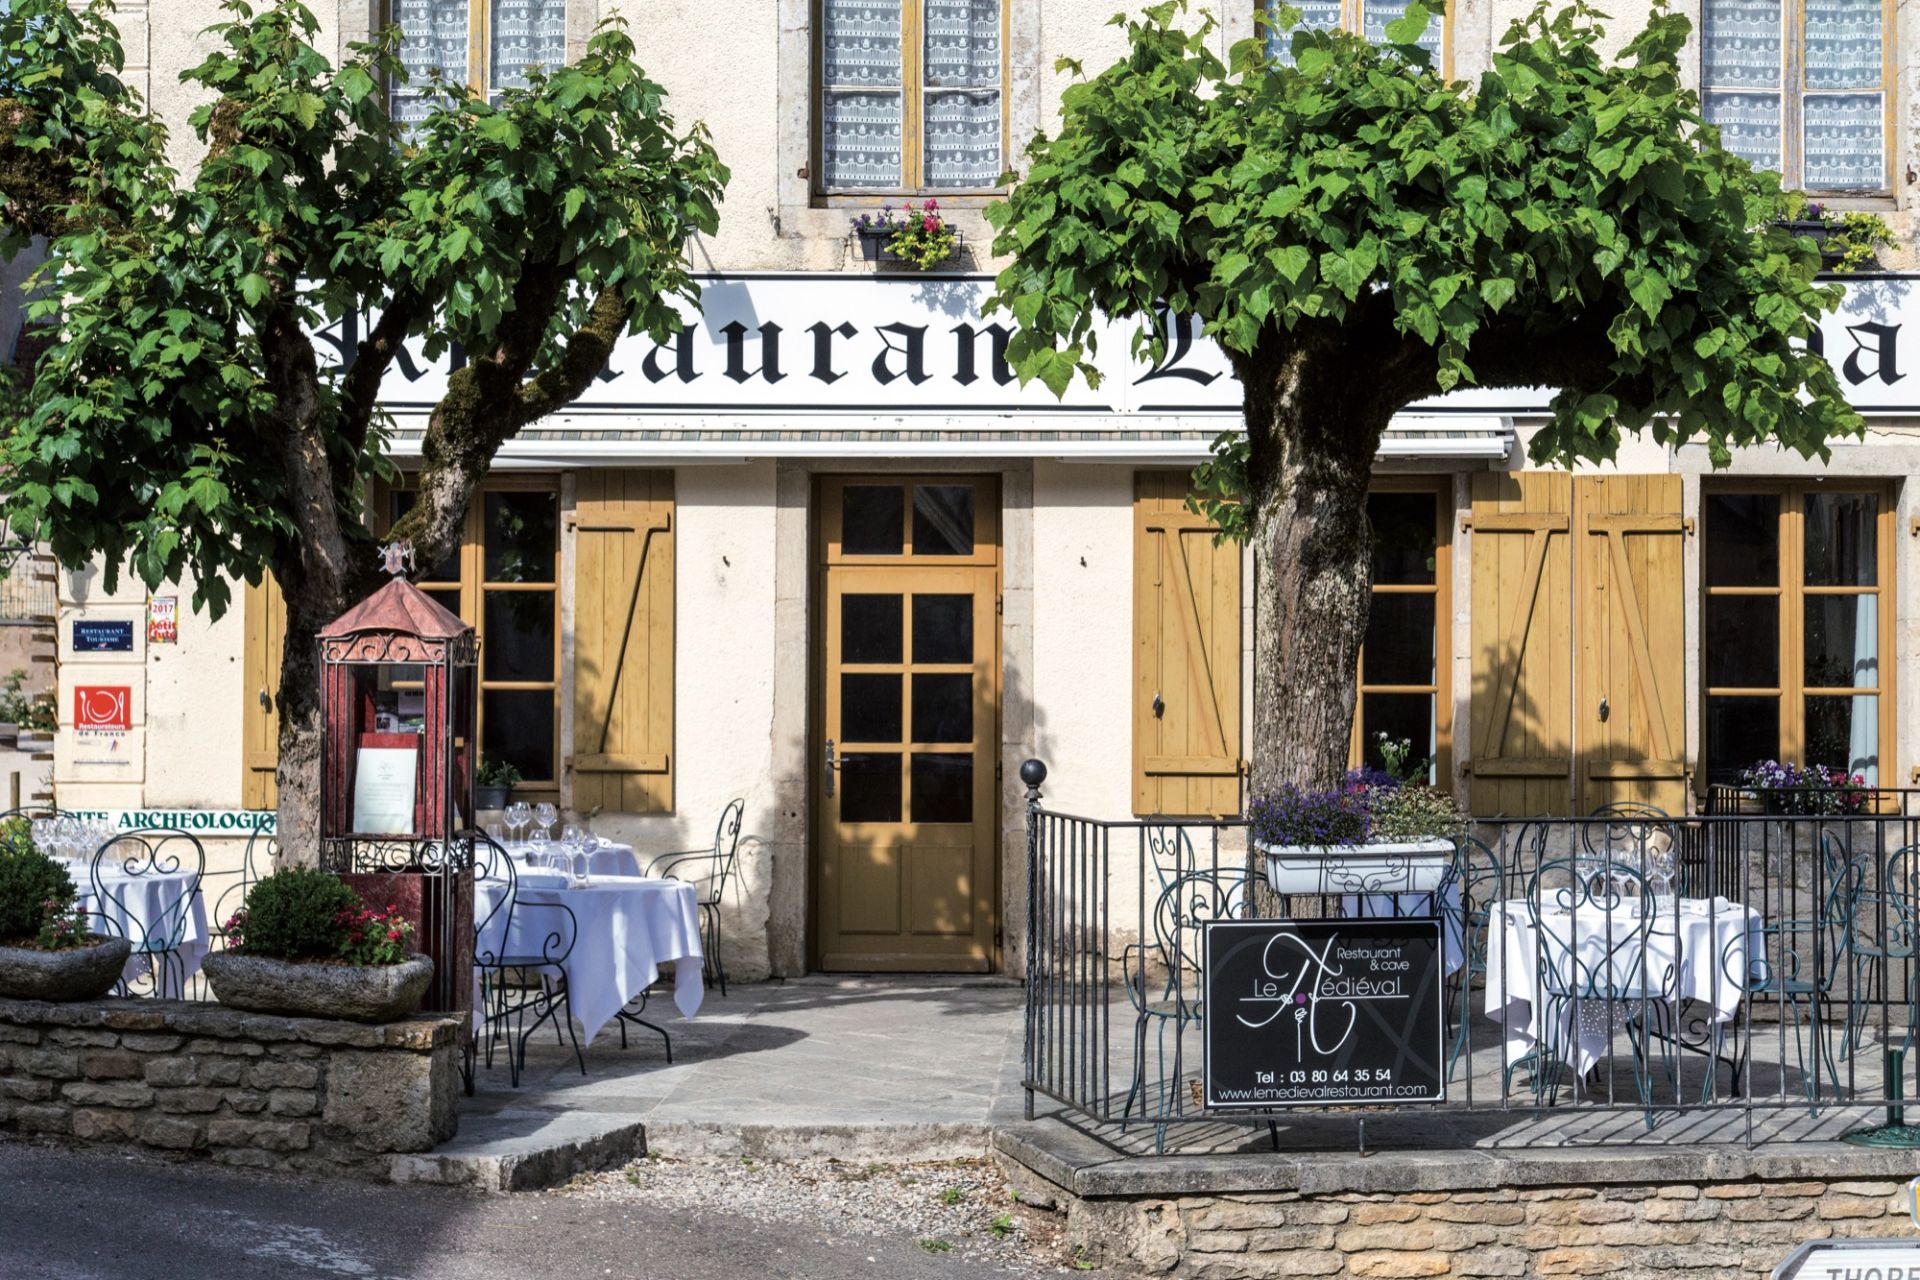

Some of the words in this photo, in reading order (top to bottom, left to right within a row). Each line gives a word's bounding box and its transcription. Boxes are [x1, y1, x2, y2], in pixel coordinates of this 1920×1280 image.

[152, 604, 174, 613] 2017
[78, 722, 126, 731] Restaurateurs
[117, 811, 276, 832] ARCHEOLOGIQ
[1336, 947, 1401, 960] Restaurant
[1369, 960, 1379, 971] &
[1380, 961, 1410, 971] cave
[1253, 978, 1278, 998] Le
[1255, 1071, 1274, 1084] Tel
[1290, 1070, 1306, 1083] 03
[1311, 1070, 1328, 1083] 80
[1332, 1069, 1349, 1082] 64
[1354, 1069, 1370, 1081] 35
[1375, 1068, 1391, 1081] 54
[1218, 1084, 1428, 1100] www.lemedievalrestaurant.com
